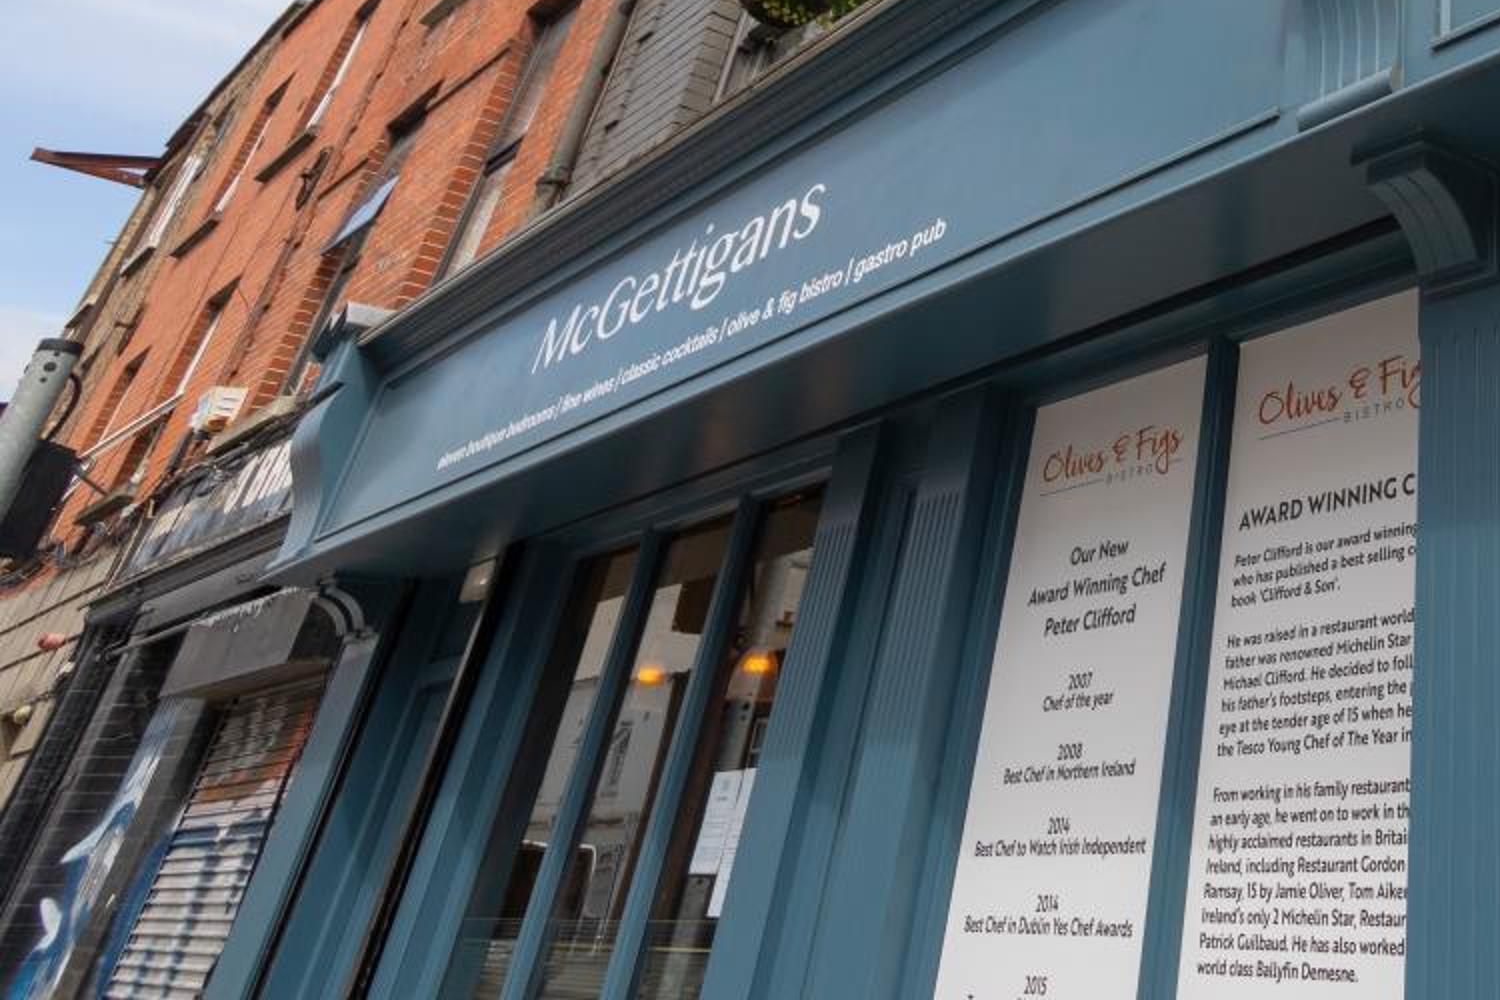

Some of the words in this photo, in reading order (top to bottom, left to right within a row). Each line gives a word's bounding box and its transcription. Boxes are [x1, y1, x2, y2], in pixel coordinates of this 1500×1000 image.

[531, 182, 826, 375] McGettigans
[777, 289, 799, 316] fig
[800, 269, 843, 304] bistro
[852, 239, 907, 284] gastro
[909, 217, 947, 257] pub
[1259, 380, 1343, 424] Olives
[1044, 445, 1104, 482] Olives
[1137, 426, 1184, 474] Figs
[1239, 499, 1302, 531] AWARD
[1308, 478, 1397, 515] WINNING
[1070, 547, 1095, 566] Our
[1099, 540, 1129, 560] New
[1234, 552, 1261, 568] Peter
[1263, 540, 1302, 563] Clifford
[1316, 539, 1334, 553] our
[1336, 530, 1370, 548] award
[1233, 573, 1254, 587] who
[1256, 569, 1273, 584] has
[1276, 558, 1328, 583] published
[1340, 553, 1364, 570] best
[1367, 545, 1405, 563] selling
[1027, 582, 1069, 606] Award
[1073, 573, 1128, 596] Winning
[1132, 561, 1166, 587] Chef
[1231, 592, 1256, 608] book
[1304, 582, 1312, 596] &
[1044, 617, 1080, 637] Peter
[1083, 604, 1136, 630] Clifford
[1227, 635, 1241, 649] He
[1243, 633, 1262, 647] was
[1264, 626, 1296, 643] raised
[1299, 625, 1309, 639] in
[1320, 615, 1377, 636] restaurant
[1379, 608, 1414, 628] world
[1225, 655, 1256, 670] father
[1258, 652, 1277, 666] was
[1279, 644, 1333, 664] renowned
[1336, 636, 1385, 656] Michelin
[1387, 631, 1411, 649] Star
[1068, 672, 1093, 690] 2007
[1223, 674, 1262, 691] Michael
[1311, 665, 1325, 680] He
[1328, 659, 1374, 678] decided
[1377, 659, 1390, 673] to
[1043, 695, 1065, 712] Chef
[1076, 693, 1091, 709] the
[1092, 692, 1113, 710] year
[1221, 698, 1235, 713] his
[1238, 691, 1277, 711] father's
[1335, 682, 1384, 702] entering
[1387, 679, 1407, 697] the
[1219, 723, 1237, 738] eye
[1239, 719, 1249, 733] at
[1252, 717, 1269, 733] the
[1272, 711, 1308, 731] tender
[1310, 713, 1329, 731] age
[1333, 708, 1345, 726] of
[1361, 703, 1394, 722] when
[1217, 741, 1235, 757] the
[1237, 738, 1265, 756] Tesco
[1267, 737, 1301, 755] Young
[1303, 733, 1330, 750] Chef
[1332, 732, 1345, 748] of
[1348, 729, 1368, 747] The
[1371, 727, 1398, 745] Year
[1003, 767, 1022, 784] Best
[1024, 766, 1044, 783] Chef
[1057, 762, 1099, 780] Northern
[1101, 758, 1136, 777] Ireland
[1213, 787, 1239, 803] From
[1240, 783, 1281, 804] working
[1283, 784, 1294, 799] in
[1296, 783, 1311, 798] his
[1314, 780, 1348, 800] family
[1351, 778, 1410, 796] restaurant
[1047, 816, 1070, 835] 2014
[1210, 813, 1223, 826] an
[1225, 812, 1249, 829] early
[1275, 808, 1288, 823] he
[1290, 807, 1317, 823] went
[1320, 808, 1334, 821] on
[1336, 806, 1349, 821] to
[1351, 804, 1379, 821] work
[1383, 802, 1395, 819] in
[975, 841, 993, 857] Best
[995, 840, 1016, 857] Chef
[1029, 839, 1057, 855] Watch
[1059, 837, 1080, 855] Irish
[1081, 834, 1147, 859] Independent
[1208, 834, 1238, 853] highly
[1241, 830, 1292, 849] acclaimed
[1295, 831, 1358, 847] restaurants
[1361, 830, 1372, 846] in
[1245, 857, 1295, 877] including
[1297, 856, 1358, 873] Restaurant
[1361, 855, 1405, 873] Gordon
[1036, 894, 1059, 912] 2014
[1259, 882, 1273, 902] by
[1275, 882, 1305, 899] Jamie
[1349, 881, 1374, 898] Tom
[963, 915, 984, 933] Best
[985, 916, 1007, 933] Chef
[1018, 916, 1051, 935] Dublin
[1053, 918, 1068, 935] Yes
[1070, 918, 1094, 936] Chef
[1094, 920, 1133, 938] Awards
[1201, 907, 1244, 925] Ireland's
[1248, 909, 1270, 928] only
[1281, 908, 1328, 926] Michelin
[1199, 932, 1234, 950] Patrick
[1291, 935, 1307, 952] He
[1311, 936, 1329, 952] has
[1332, 935, 1356, 954] also
[1360, 936, 1406, 956] worked
[1198, 957, 1227, 975] world
[1229, 959, 1253, 977] class
[1256, 960, 1298, 983] Ballyfin
[1024, 976, 1048, 995] 2015
